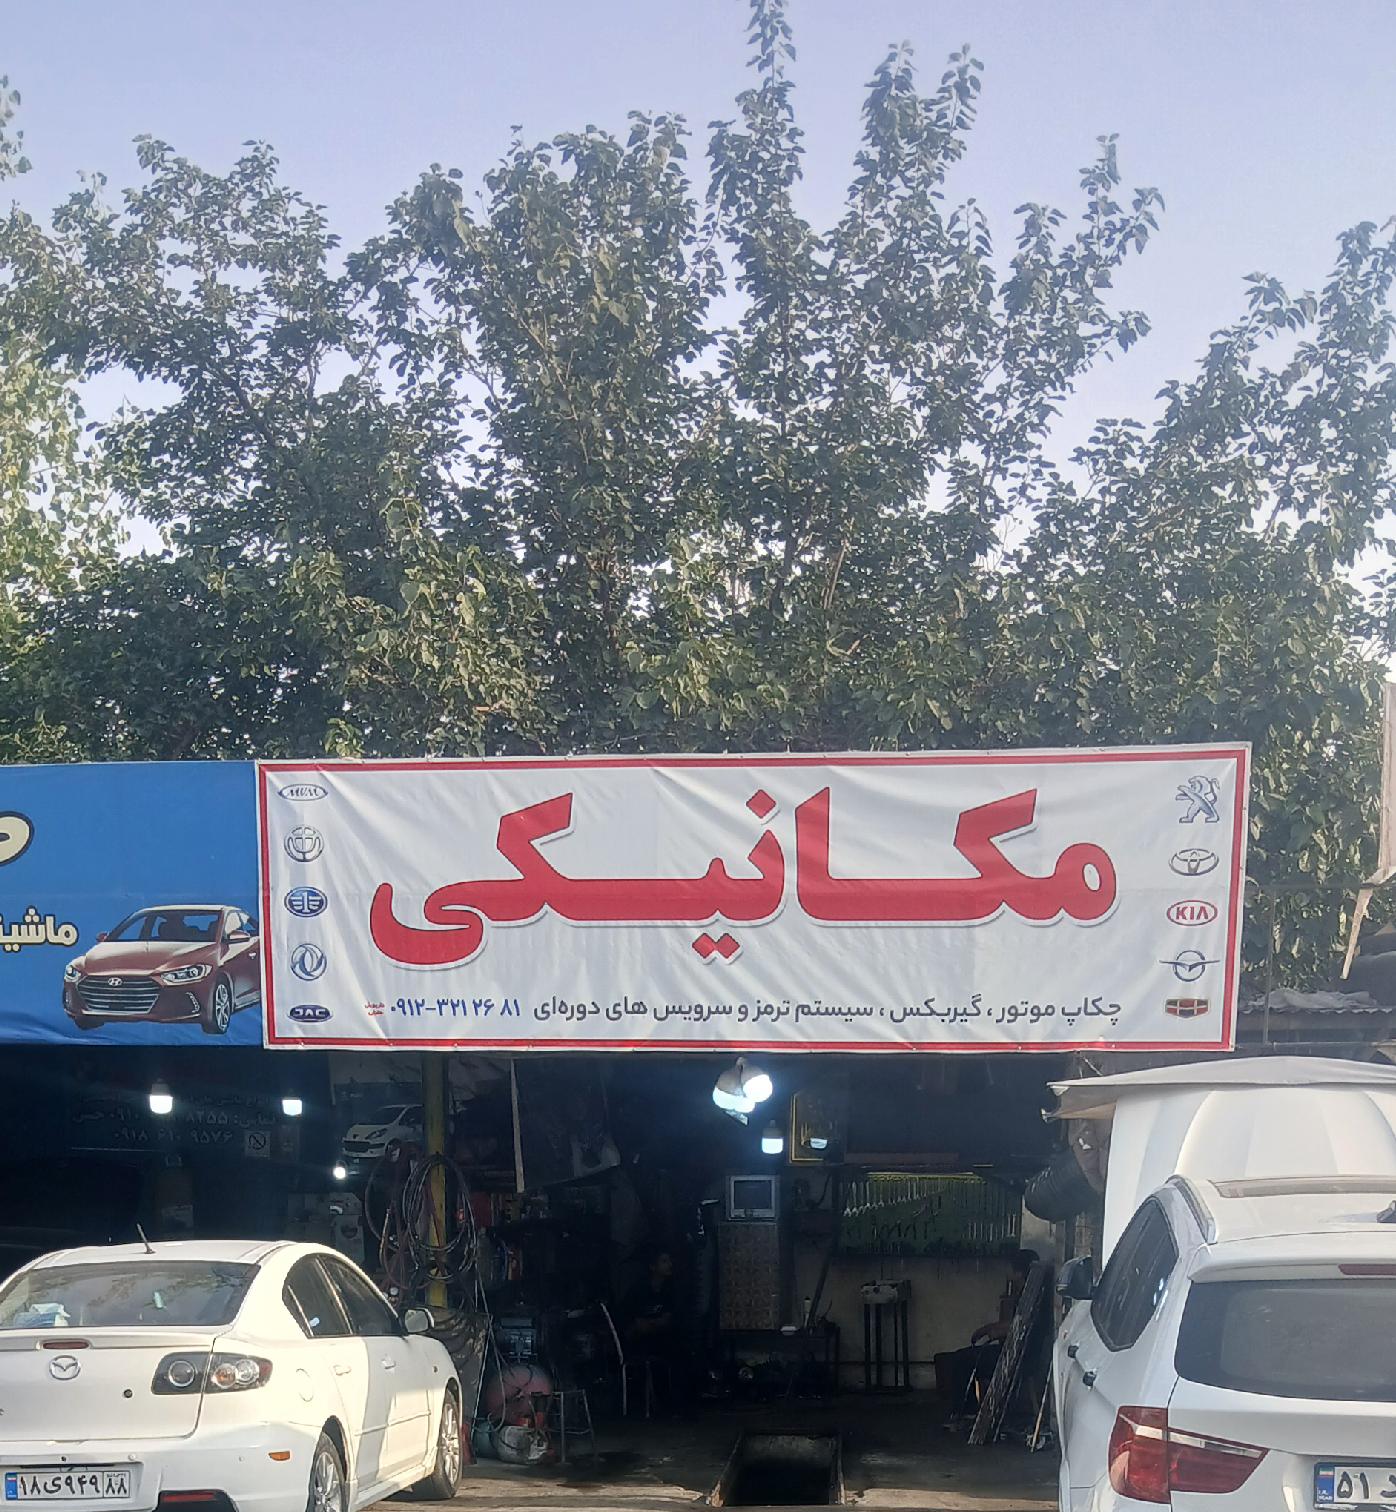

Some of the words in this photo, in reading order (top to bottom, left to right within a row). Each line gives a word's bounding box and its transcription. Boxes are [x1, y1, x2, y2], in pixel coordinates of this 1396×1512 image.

[370, 786, 1117, 967] مکانیکی
[0, 906, 79, 952] ماشی
[606, 996, 648, 1021] های
[653, 1002, 733, 1022] سرویس
[737, 1003, 748, 1022] و
[752, 1001, 790, 1024] ترمز
[795, 1001, 873, 1024] سیستم
[890, 994, 981, 1024] گیربکس
[1062, 997, 1122, 1026] چکاپ
